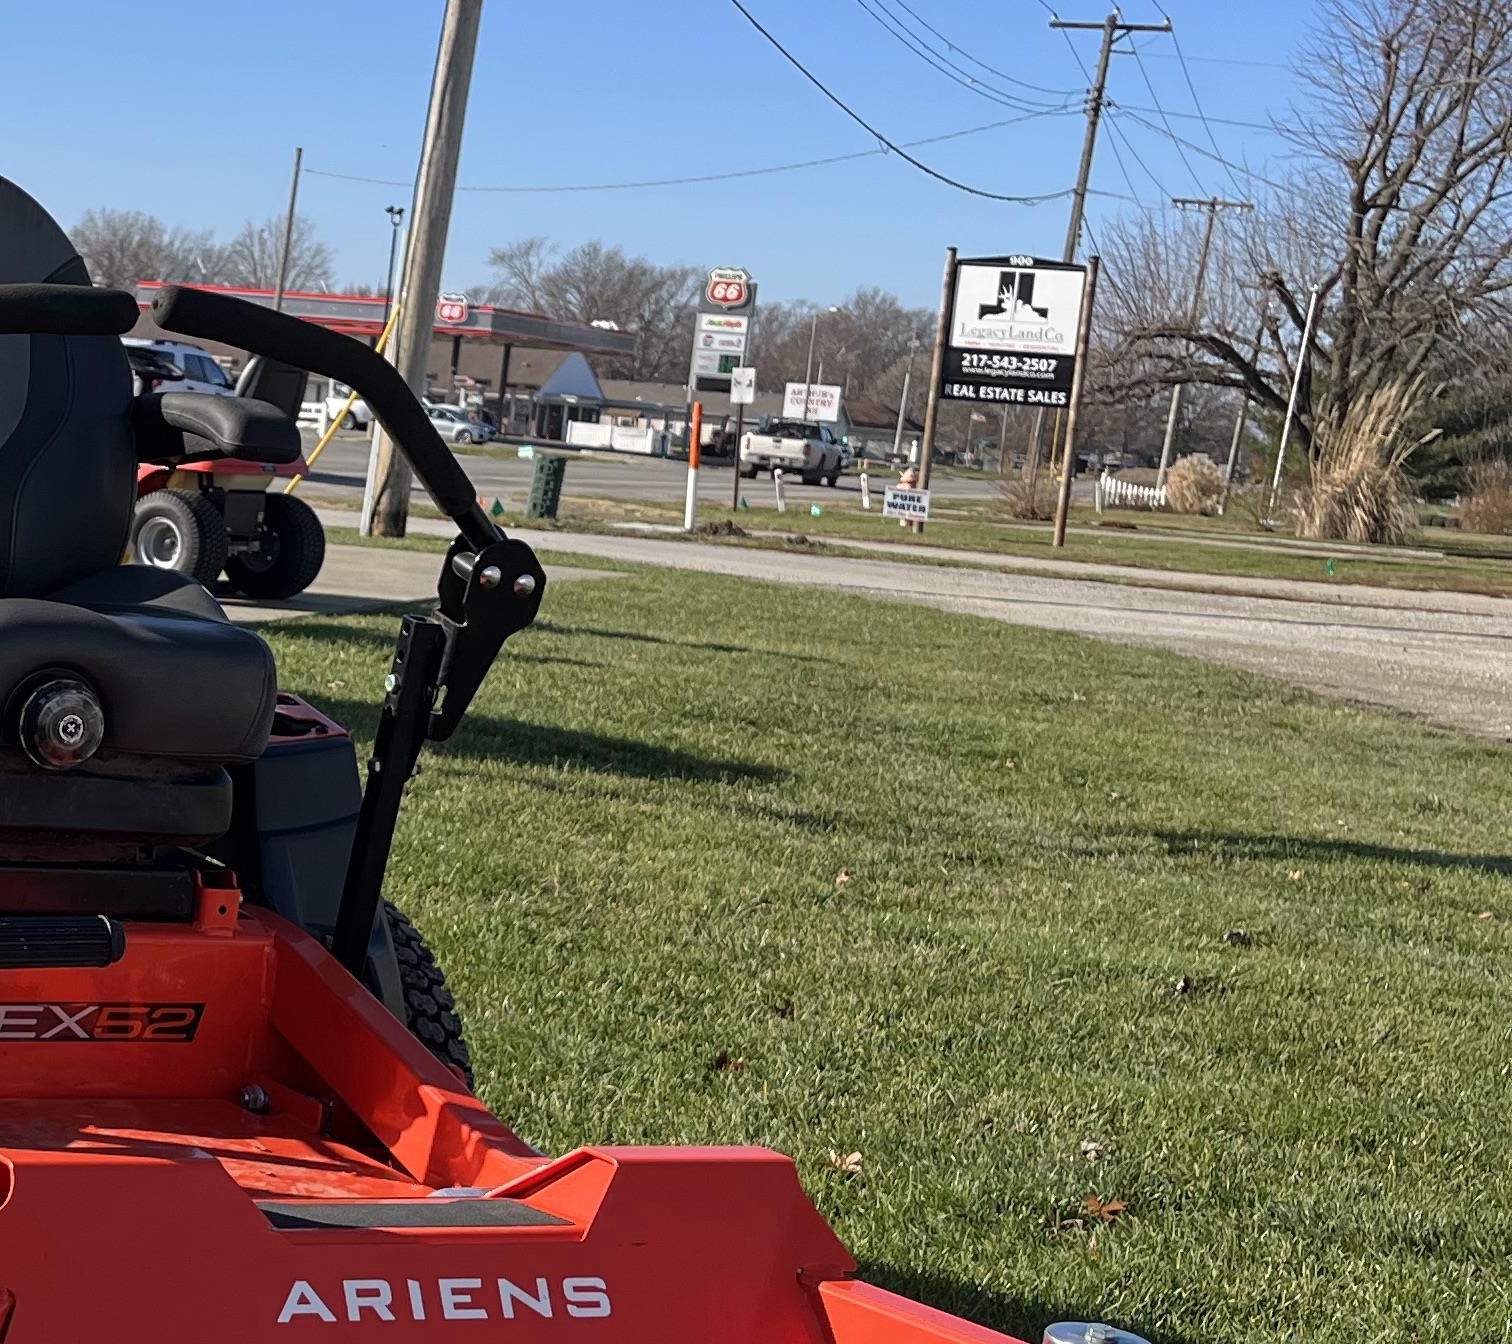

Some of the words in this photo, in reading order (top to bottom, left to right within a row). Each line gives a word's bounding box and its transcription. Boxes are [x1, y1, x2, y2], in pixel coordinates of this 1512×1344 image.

[713, 283, 740, 300] 66
[961, 352, 1058, 372] 217-543-2507
[944, 383, 976, 398] REAL
[979, 386, 1025, 402] ESTATE
[1027, 389, 1067, 405] SALES
[276, 1276, 612, 1323] ARIENS
